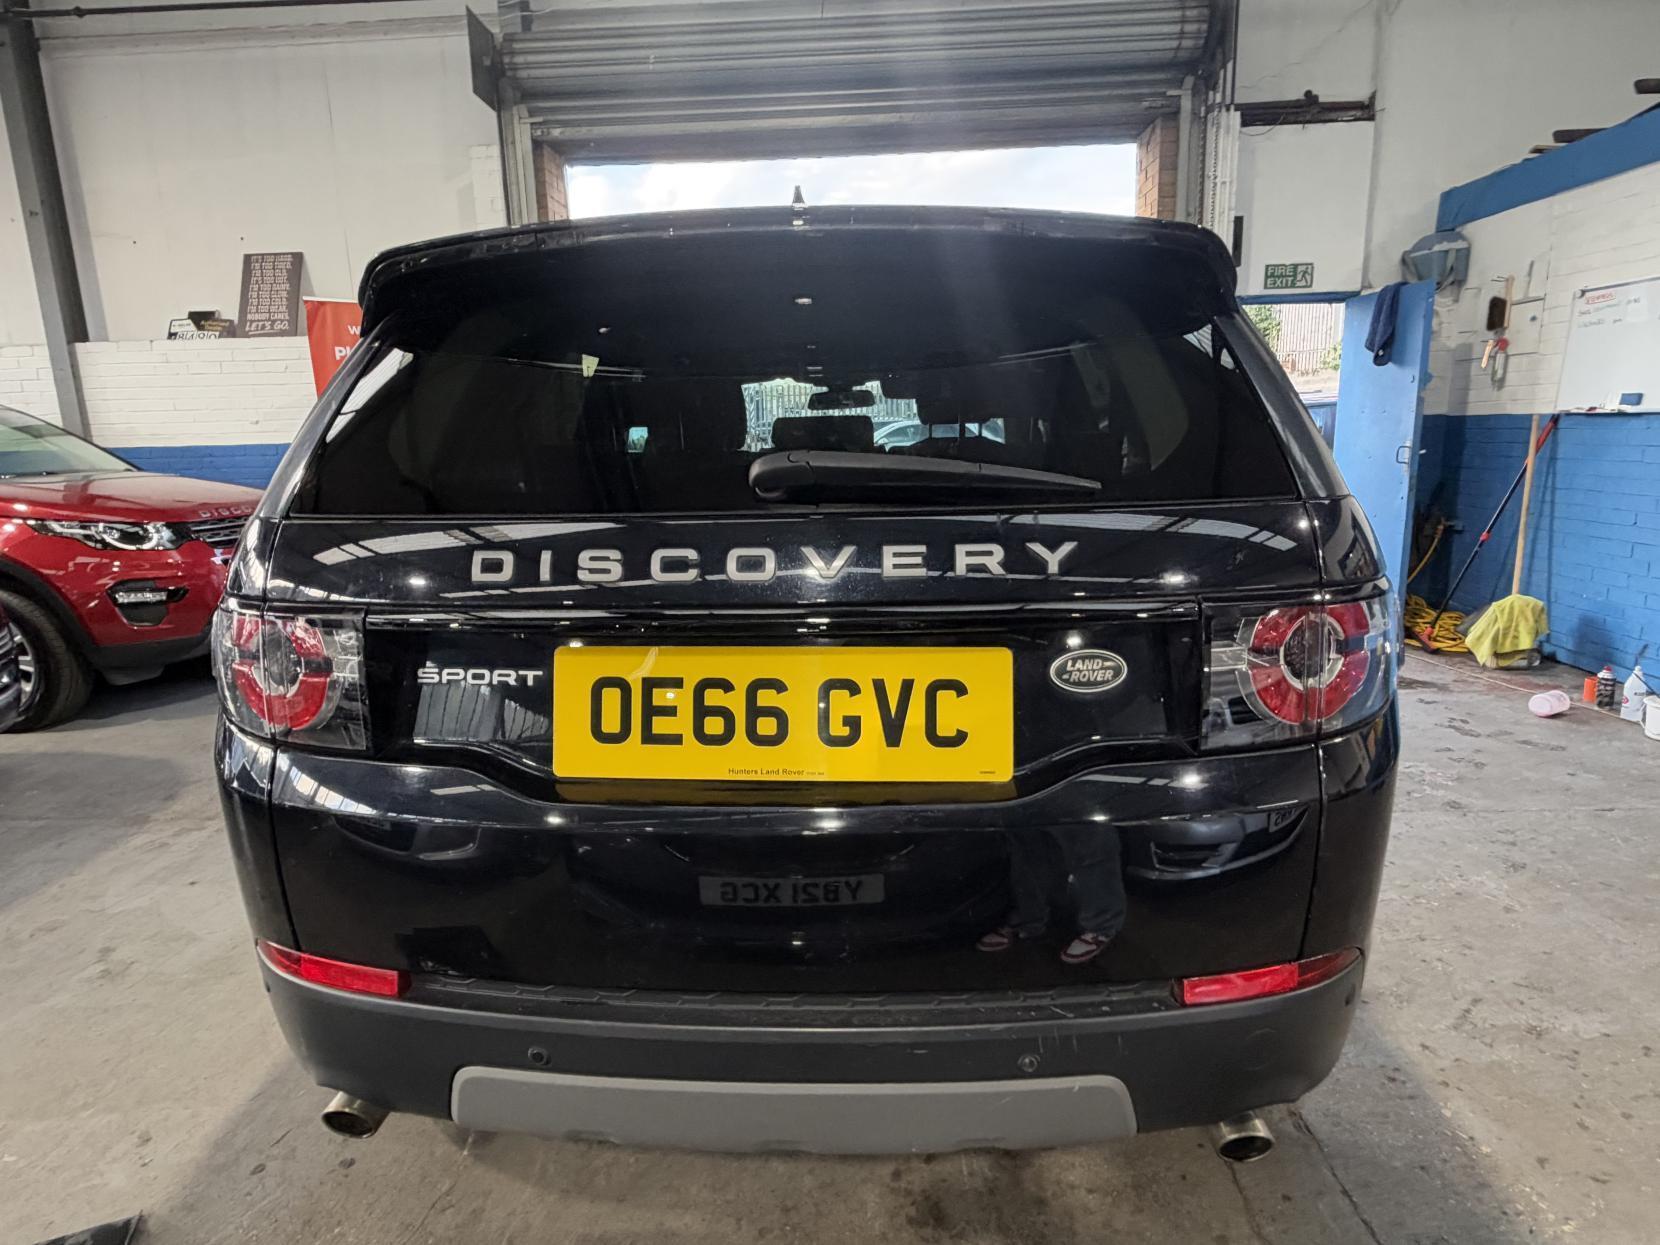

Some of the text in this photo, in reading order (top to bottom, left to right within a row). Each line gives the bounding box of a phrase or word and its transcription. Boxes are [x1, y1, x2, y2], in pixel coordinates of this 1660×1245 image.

[1267, 265, 1295, 276] FIRE
[1266, 277, 1294, 288] EXIT
[259, 291, 270, 299] TOO
[245, 321, 289, 331] LET'S GO.
[200, 506, 252, 517] DISCO
[471, 541, 1078, 582] DISCOVERY
[1066, 658, 1103, 671] LAND
[417, 668, 544, 686] SPORT
[1069, 669, 1114, 682] ROVER
[590, 676, 969, 748] OE66 GVC
[728, 767, 758, 775] Hunters
[760, 767, 780, 776] Land
[782, 768, 805, 776] Rover
